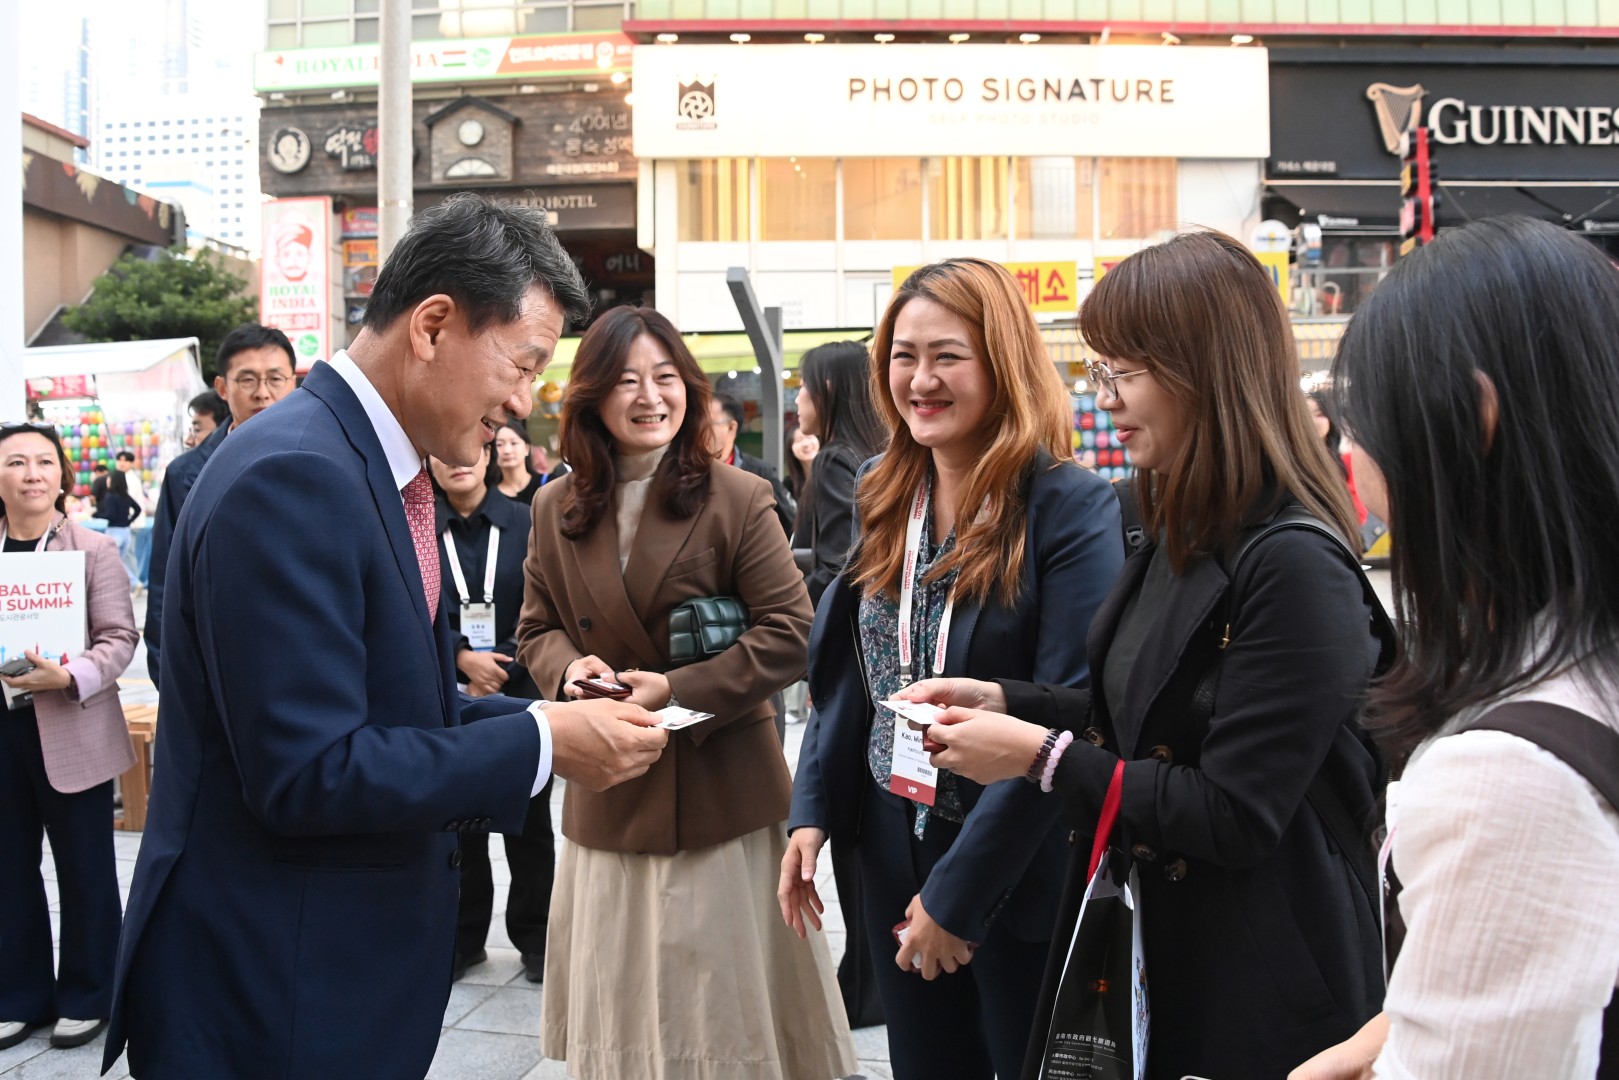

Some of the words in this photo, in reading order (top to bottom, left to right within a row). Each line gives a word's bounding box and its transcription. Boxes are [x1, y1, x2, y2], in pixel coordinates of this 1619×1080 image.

[848, 77, 964, 102] PHOTO
[981, 77, 1176, 103] SIGNATURE
[976, 113, 1031, 125] PHOTO
[1039, 113, 1100, 125] STUDIO
[546, 194, 598, 209] HOTEL
[268, 284, 318, 297] ROYAL
[272, 298, 317, 309] INDIA
[36, 582, 73, 595] CITY
[907, 785, 918, 795] VIP
